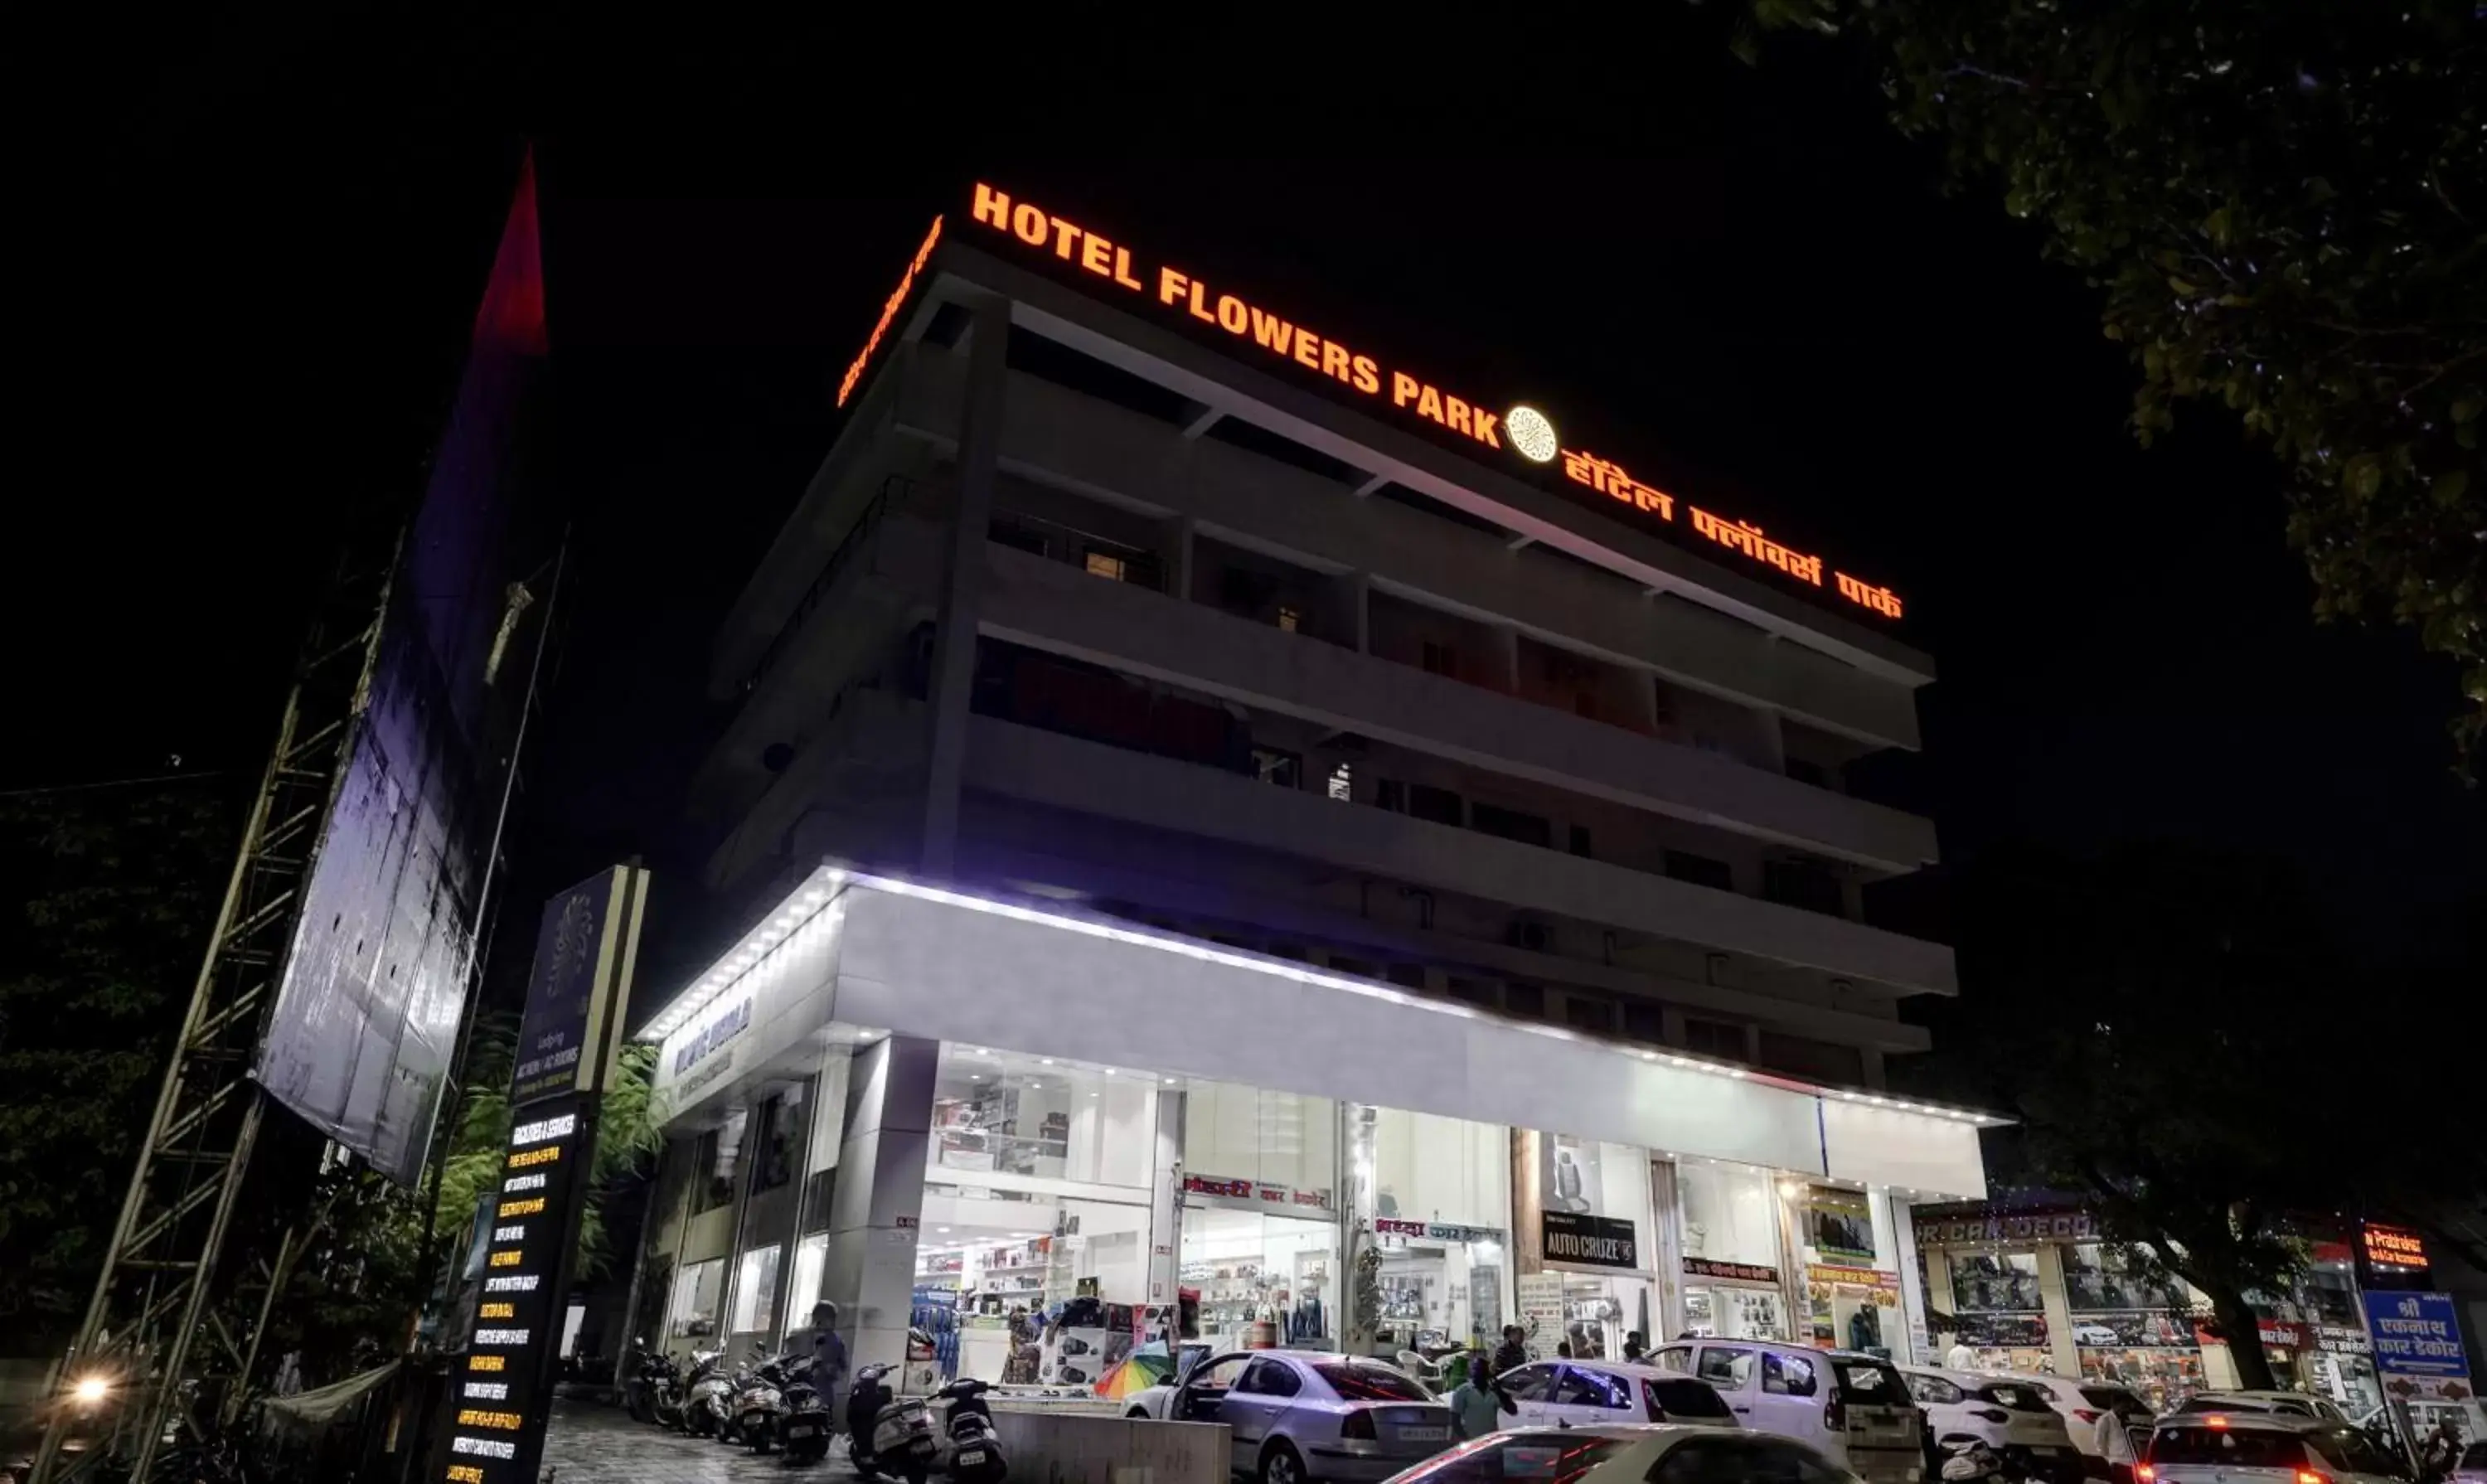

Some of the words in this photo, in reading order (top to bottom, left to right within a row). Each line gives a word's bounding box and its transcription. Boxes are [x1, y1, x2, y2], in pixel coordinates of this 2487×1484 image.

[972, 182, 1142, 291] HOTEL
[1160, 266, 1379, 394] FLOWERS
[1394, 371, 1500, 449] PARK
[1560, 449, 1674, 521] हॉटेल
[1689, 506, 1822, 586] फ्लॉवर्स
[1835, 571, 1902, 618] पार्क
[1429, 1226, 1461, 1240] कार
[1548, 1232, 1579, 1255] AUTO
[1581, 1234, 1620, 1261] CRUZE
[2397, 1297, 2420, 1317] श्री
[2378, 1318, 2447, 1336] एकनाथ
[2376, 1337, 2412, 1355] कार
[2412, 1336, 2460, 1358] डेकोर
